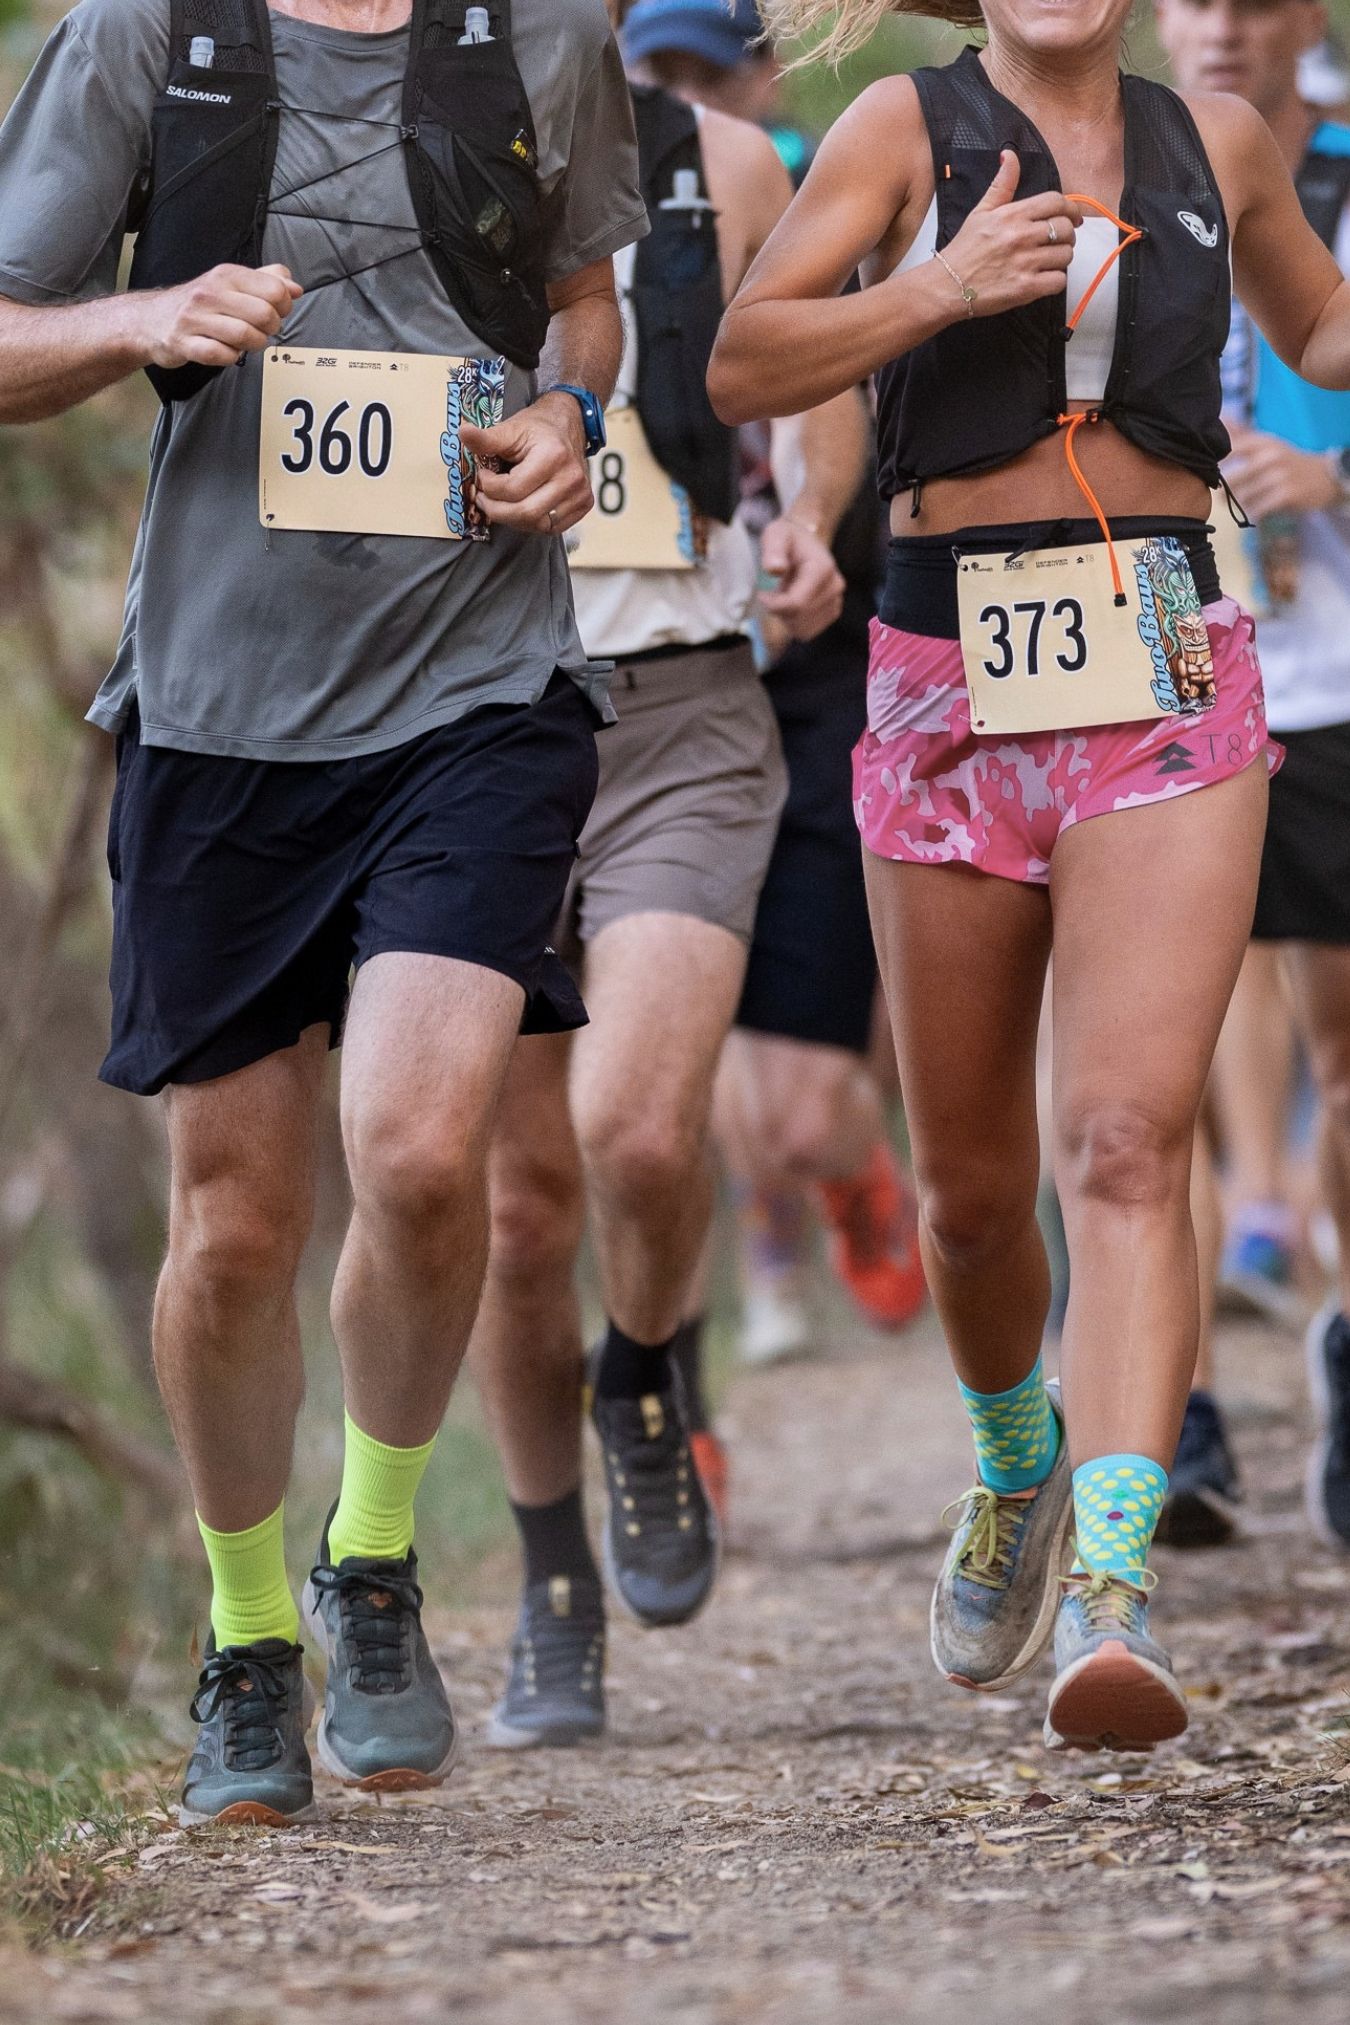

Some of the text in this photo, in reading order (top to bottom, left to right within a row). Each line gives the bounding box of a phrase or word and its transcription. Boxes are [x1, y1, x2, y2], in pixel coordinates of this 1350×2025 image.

[166, 85, 231, 104] SALOMON
[281, 399, 392, 477] 360
[444, 462, 464, 537] Two
[587, 452, 625, 515] 8
[979, 598, 1087, 679] 373
[1150, 643, 1181, 713] Two
[1200, 733, 1243, 766] T8
